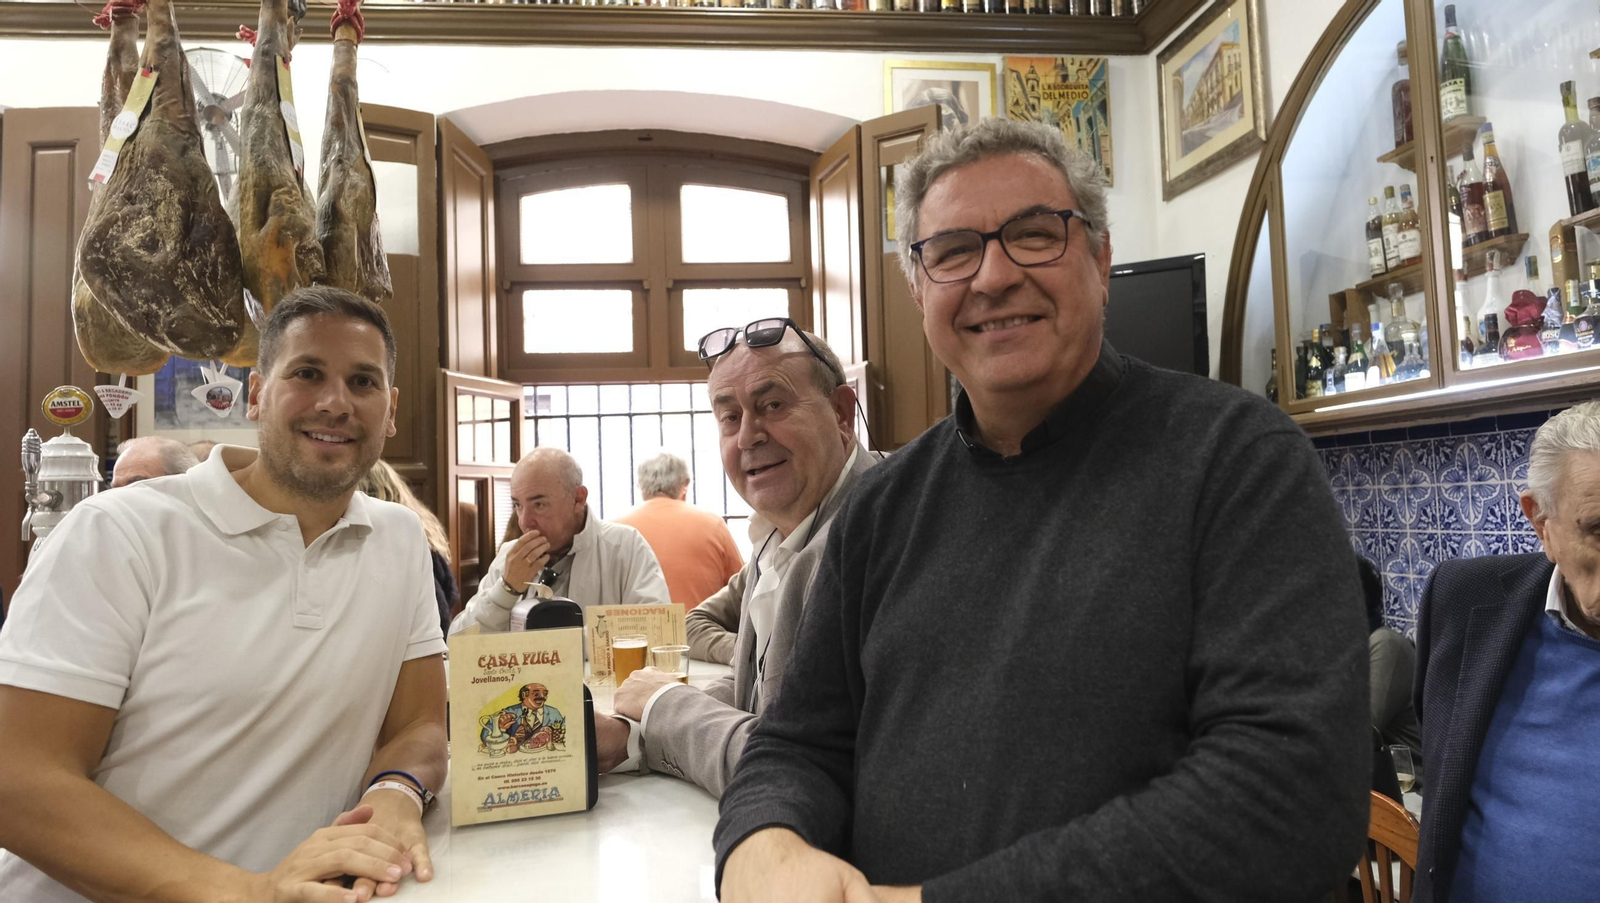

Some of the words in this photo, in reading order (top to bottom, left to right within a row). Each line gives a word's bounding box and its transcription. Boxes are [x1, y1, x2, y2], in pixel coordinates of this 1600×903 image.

[1042, 91, 1058, 100] DEL
[1059, 90, 1089, 100] MEDIO
[50, 400, 81, 408] AMSTEL
[605, 607, 666, 617] RACIONES
[478, 653, 519, 670] CASA
[522, 650, 561, 665] PUGA
[471, 674, 515, 684] Jovellanos,7
[482, 786, 561, 807] ALMERIA
